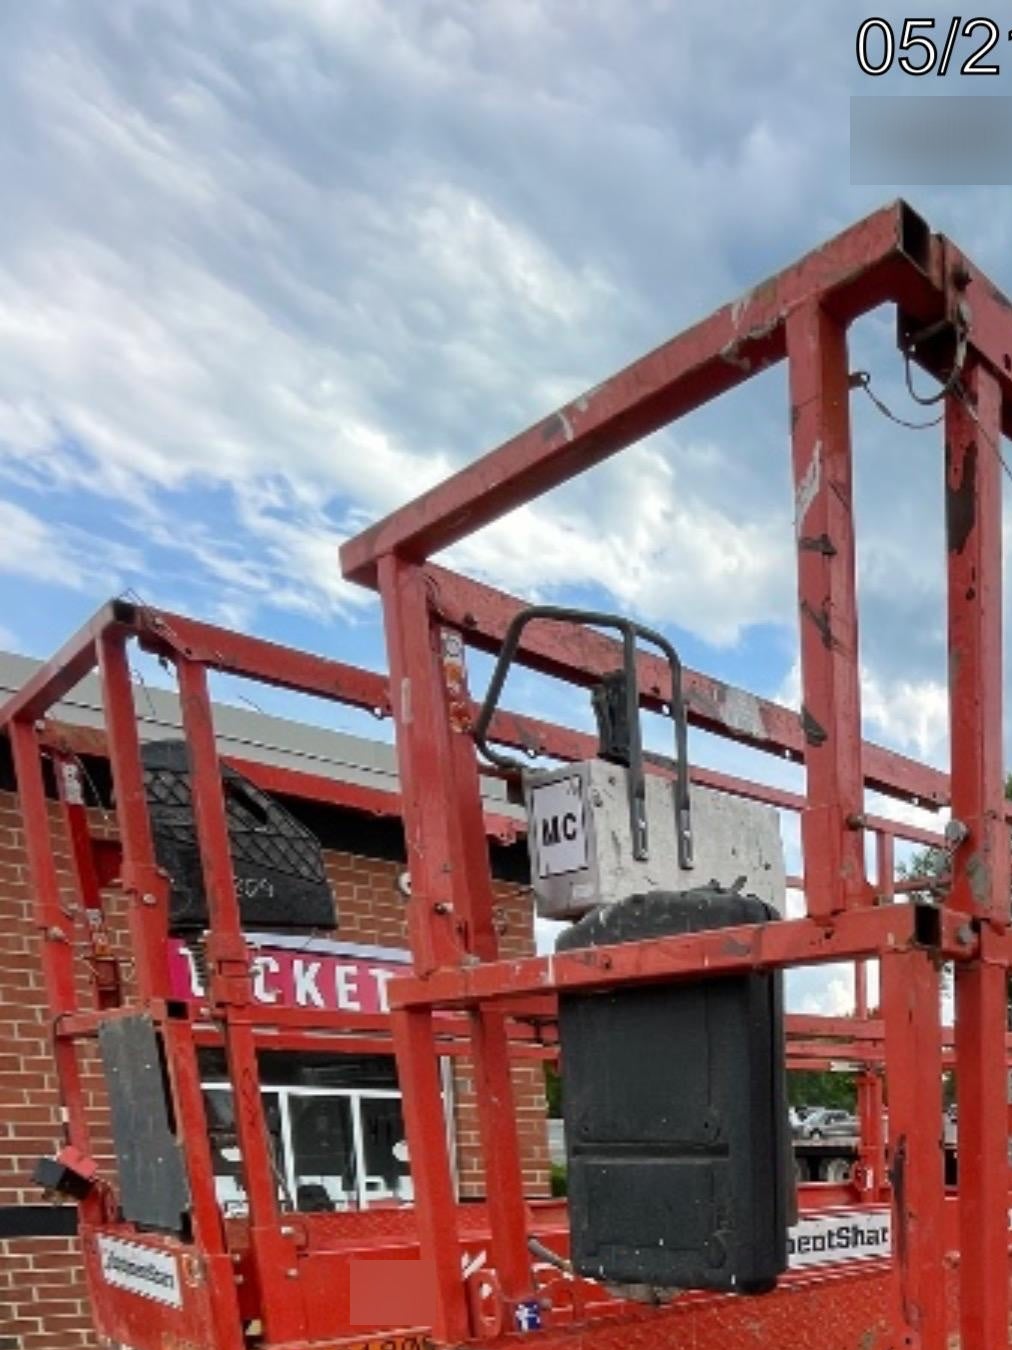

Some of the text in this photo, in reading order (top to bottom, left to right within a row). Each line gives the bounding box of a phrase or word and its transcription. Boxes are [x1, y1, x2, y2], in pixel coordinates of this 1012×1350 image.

[541, 812, 577, 847] MC
[179, 947, 395, 1014] TCKET
[785, 1224, 889, 1255] entShar
